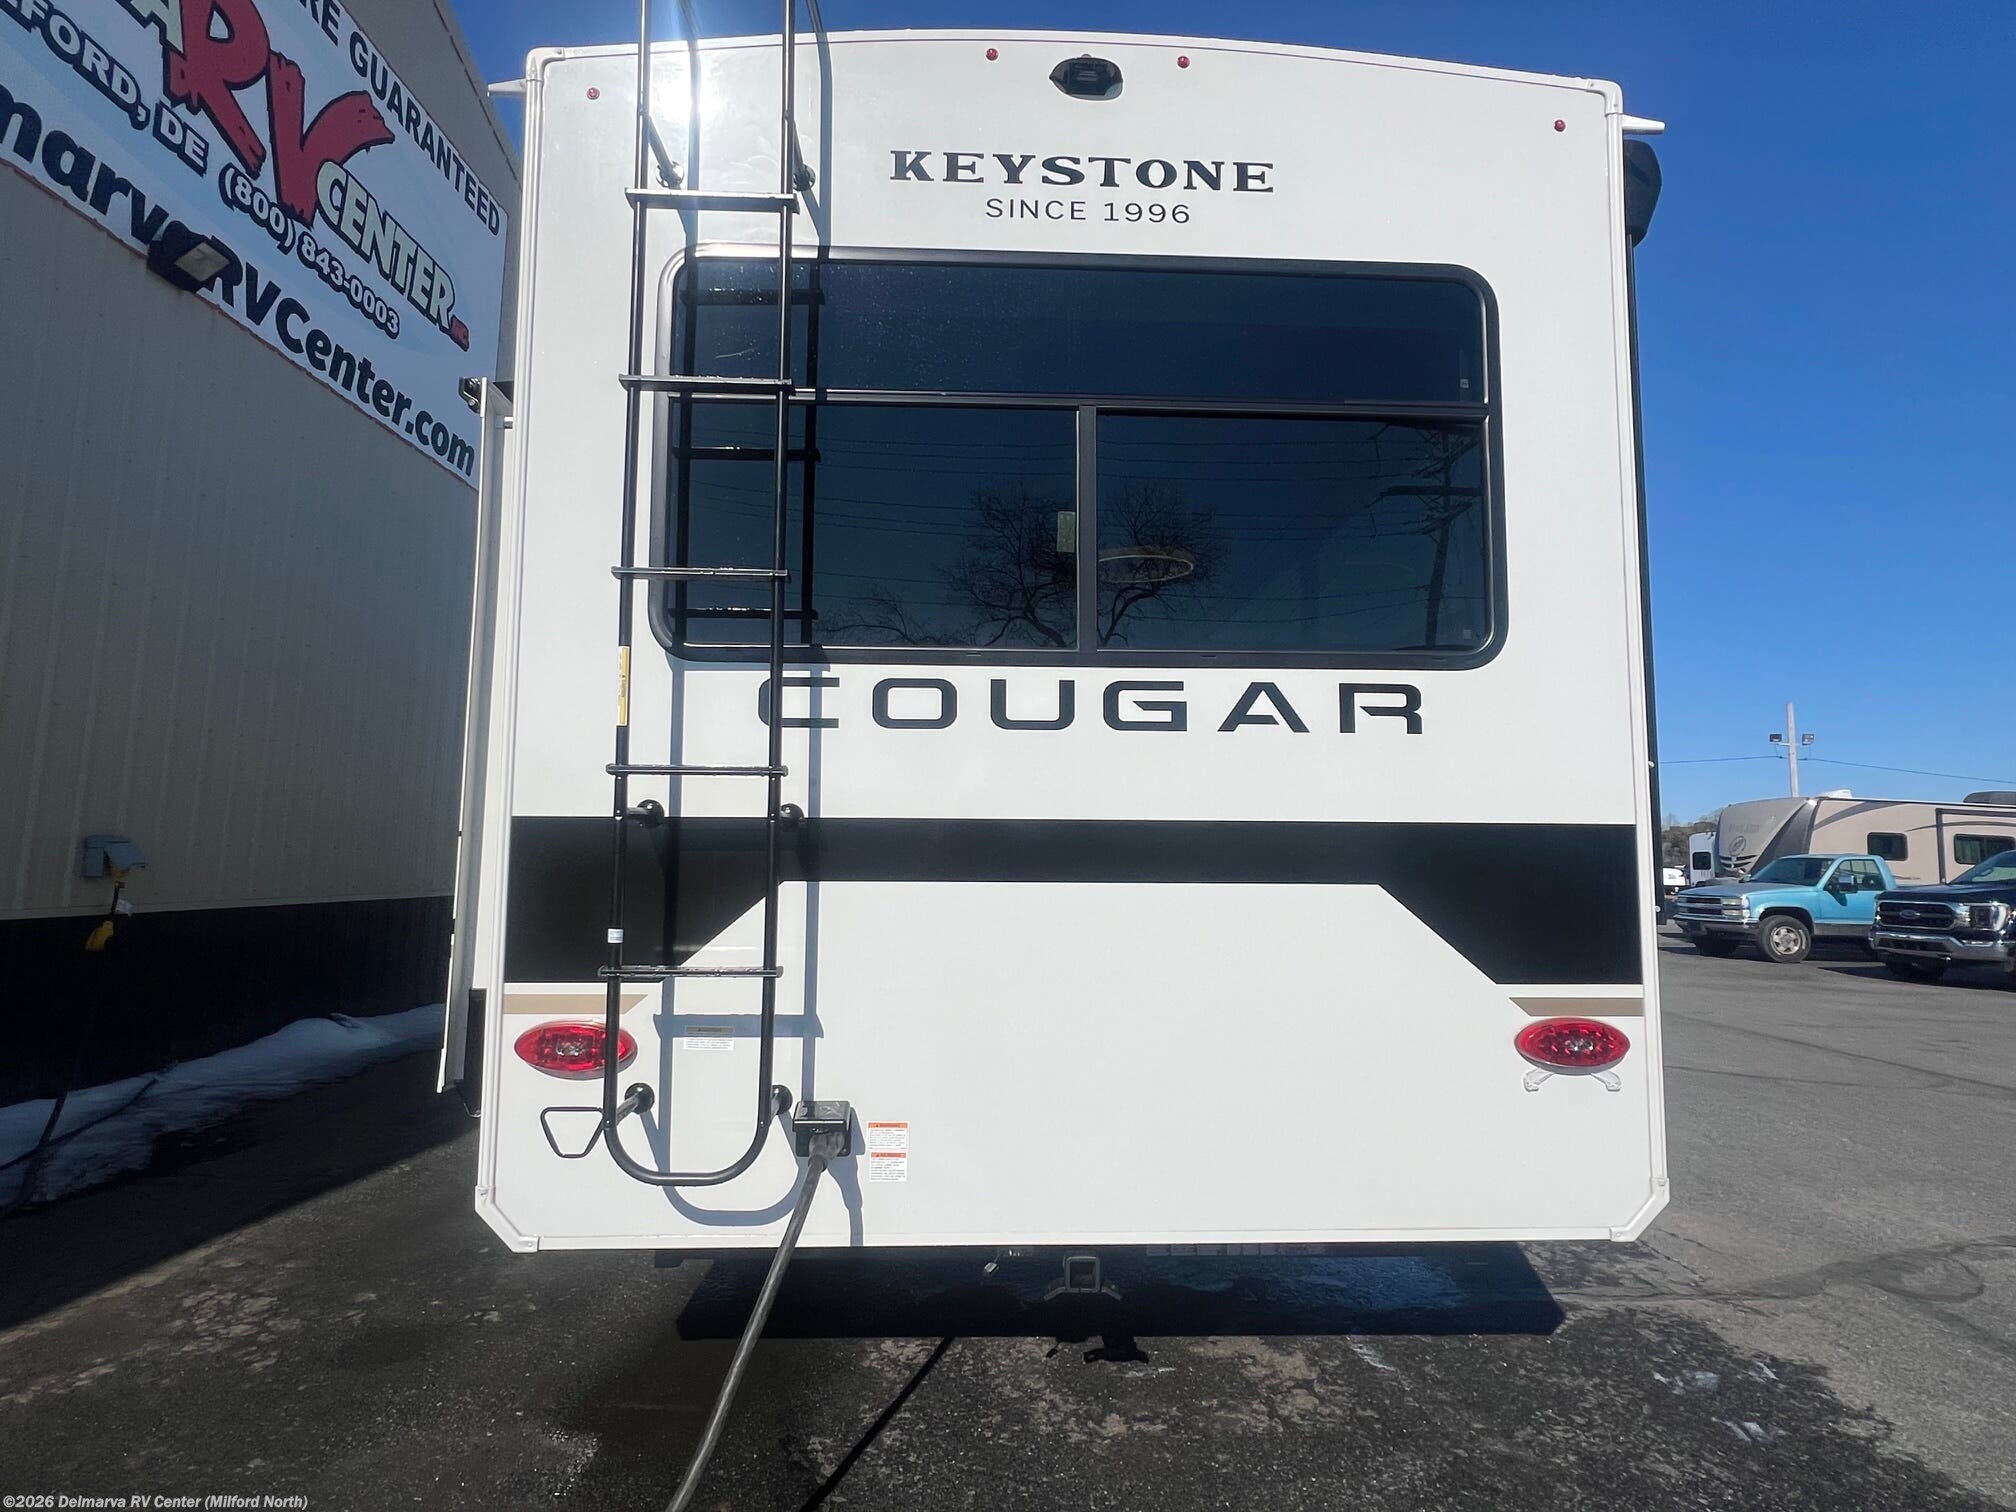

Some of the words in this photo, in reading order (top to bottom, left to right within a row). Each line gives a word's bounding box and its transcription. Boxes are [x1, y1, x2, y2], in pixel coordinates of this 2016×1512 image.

[154, 100, 208, 176] DE
[219, 163, 296, 252] (800)
[298, 232, 400, 338] 843-0003
[350, 31, 500, 236] GUARANTEED
[889, 150, 1274, 193] KEYSTONE
[985, 198, 1087, 221] SINCE
[1103, 202, 1190, 224] 1996
[0, 83, 475, 477] marvRVCenter.com
[316, 161, 455, 332] CENTER
[758, 678, 1423, 735] COUGAR
